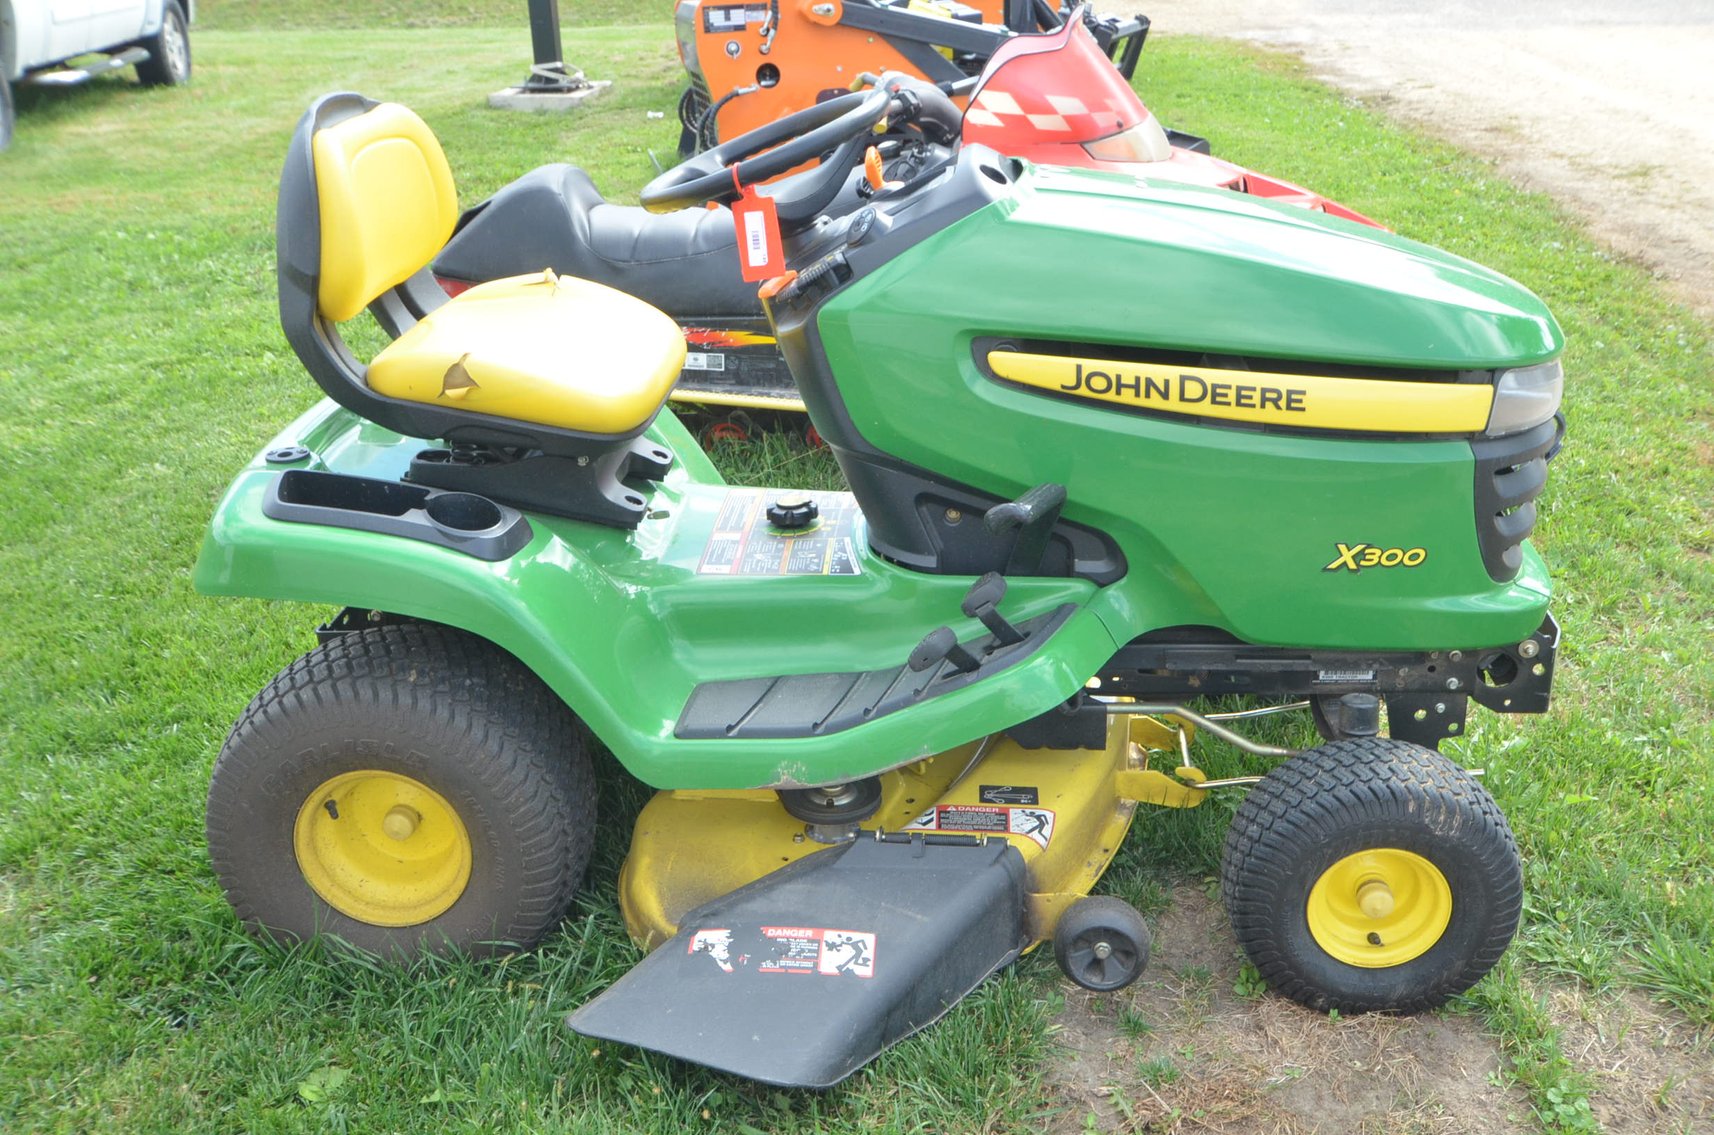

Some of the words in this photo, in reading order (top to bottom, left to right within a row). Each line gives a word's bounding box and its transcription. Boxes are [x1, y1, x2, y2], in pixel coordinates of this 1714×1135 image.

[1061, 363, 1169, 401] JOHN
[1178, 374, 1307, 412] DEERE
[1322, 543, 1427, 572] X300
[767, 928, 813, 938] DANGER
